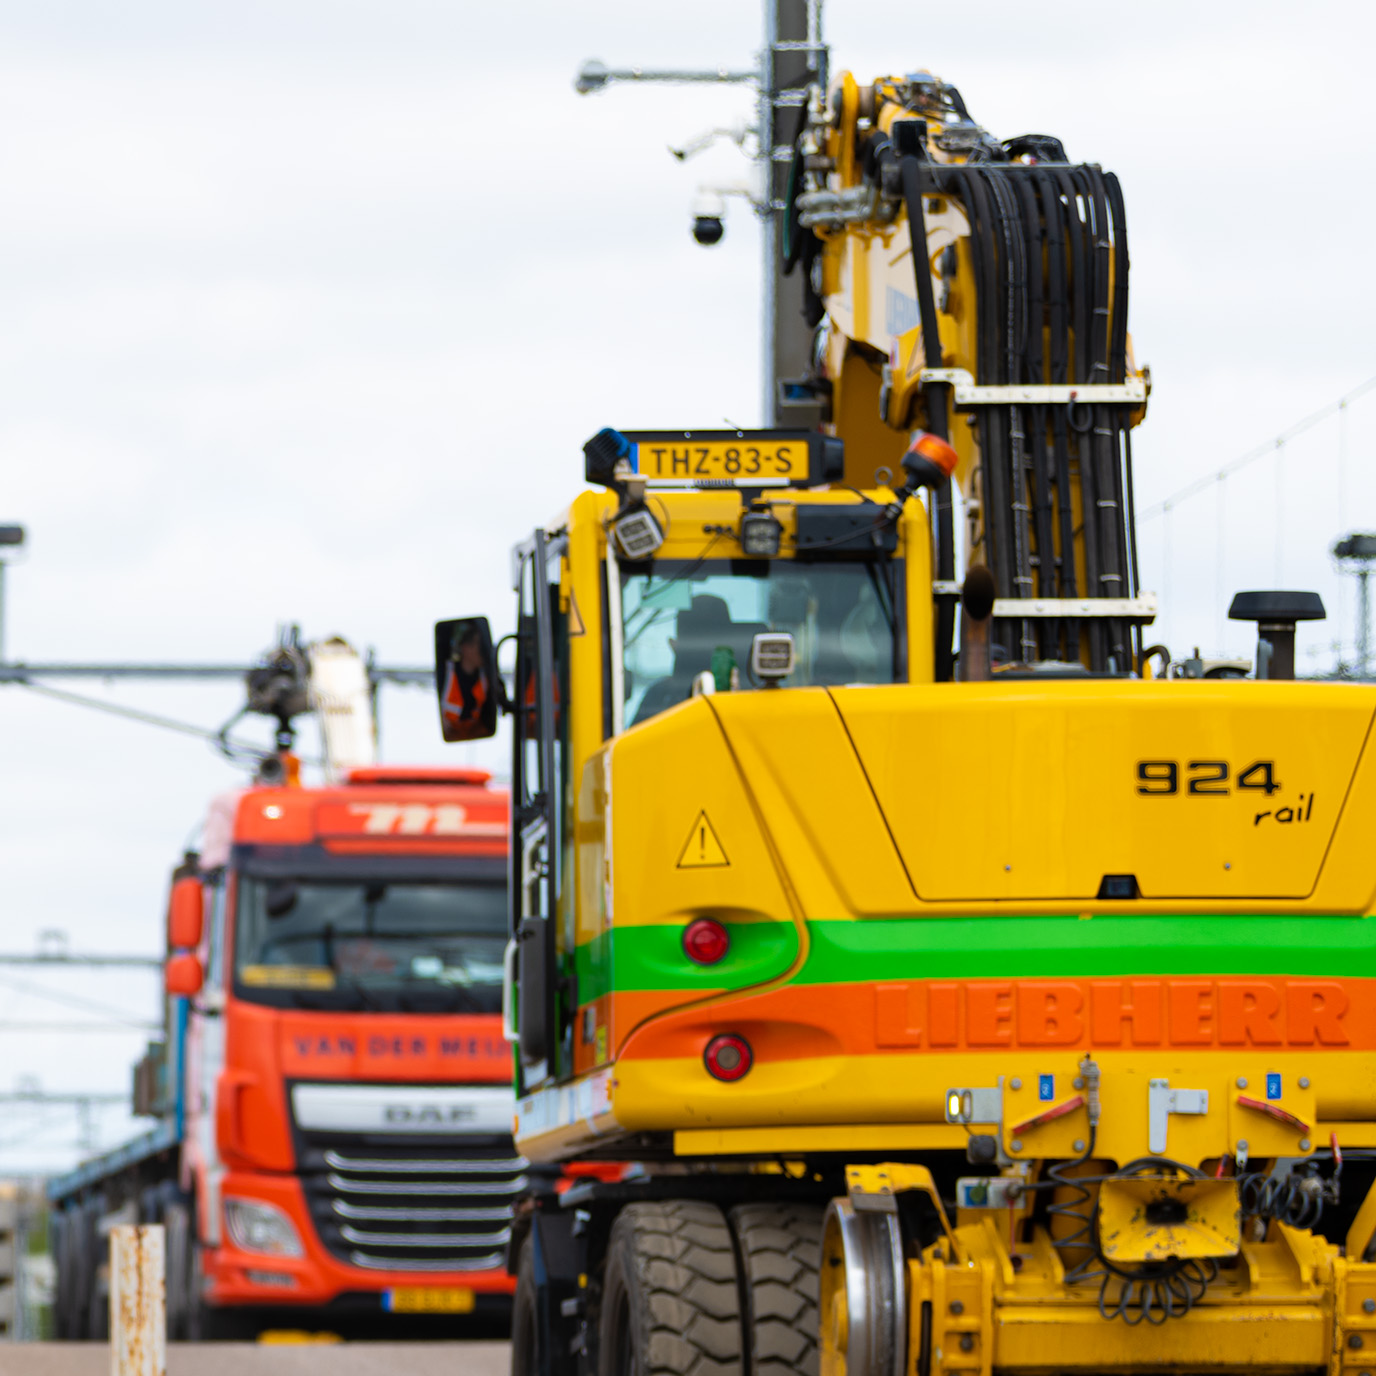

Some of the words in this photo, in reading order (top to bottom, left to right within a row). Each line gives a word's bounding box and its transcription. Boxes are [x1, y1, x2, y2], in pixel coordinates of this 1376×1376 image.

[650, 447, 792, 474] THZ-83-S
[1137, 761, 1281, 795] 924
[1253, 792, 1315, 827] rail
[874, 980, 1351, 1048] LIEBHERR
[294, 1036, 356, 1058] VAN
[367, 1035, 427, 1059] DER
[383, 1104, 478, 1124] DAF
